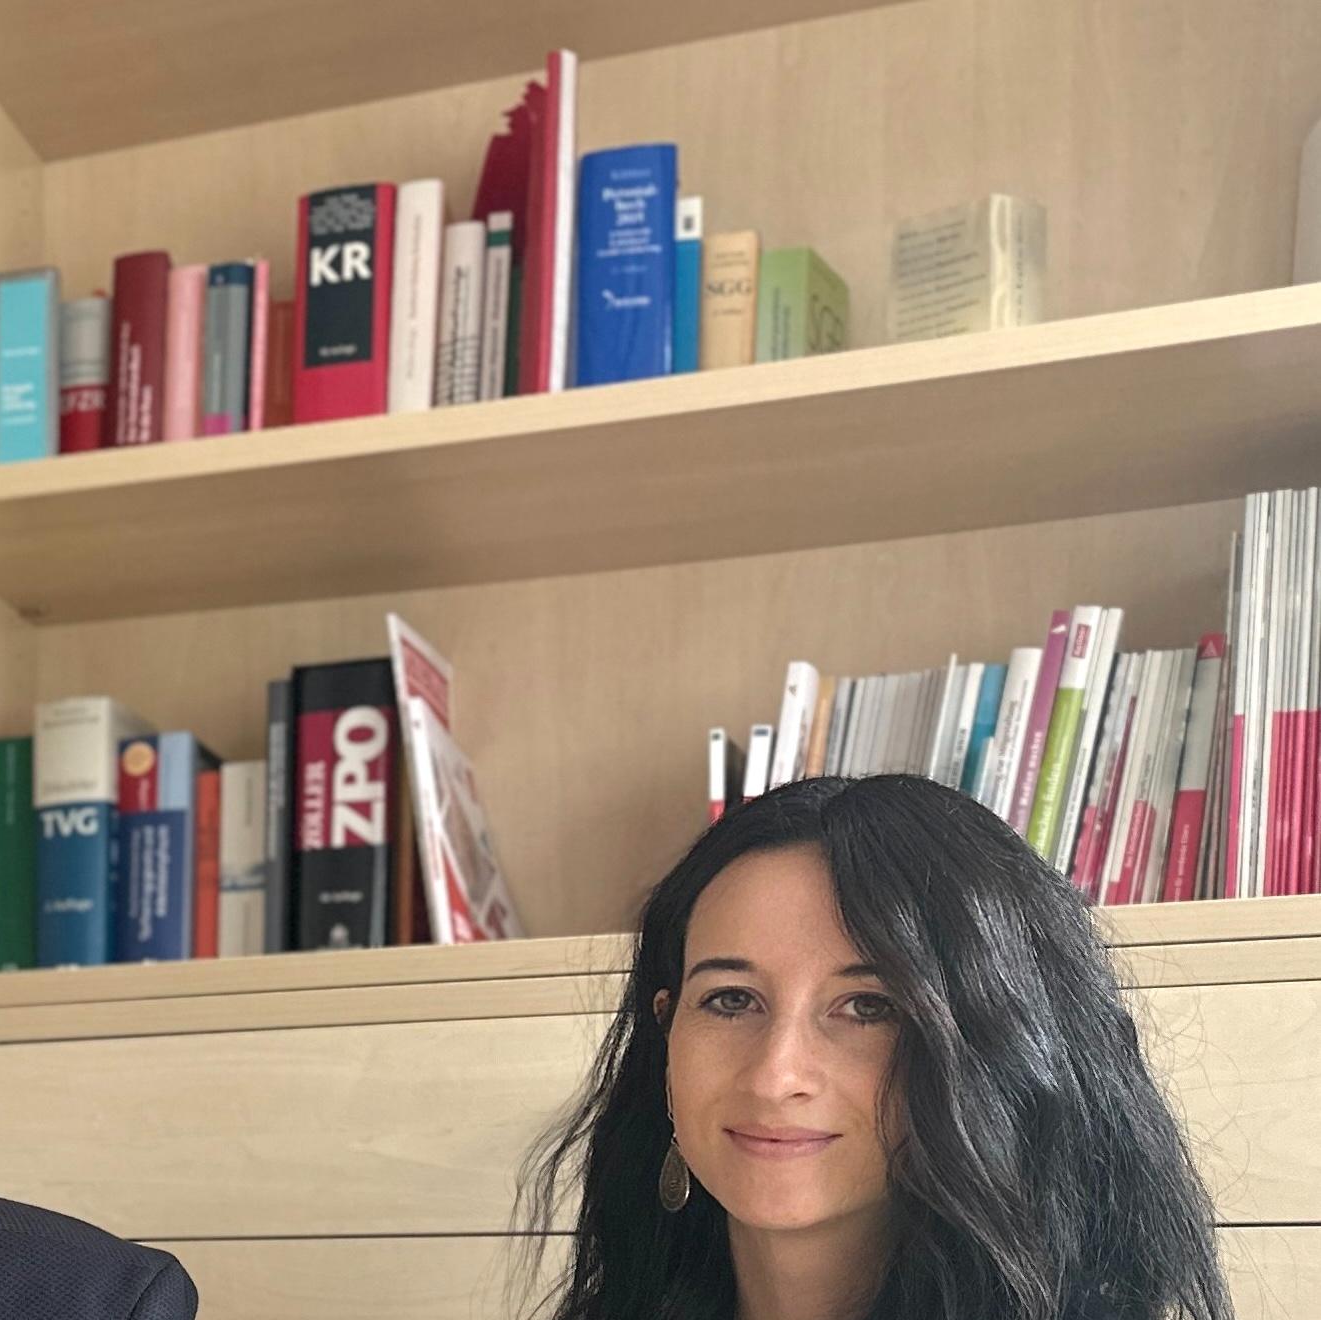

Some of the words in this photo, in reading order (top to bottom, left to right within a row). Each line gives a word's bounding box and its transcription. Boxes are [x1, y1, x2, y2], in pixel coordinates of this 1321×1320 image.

[309, 241, 374, 287] KR
[331, 705, 389, 849] ZPO
[40, 808, 99, 838] TVG
